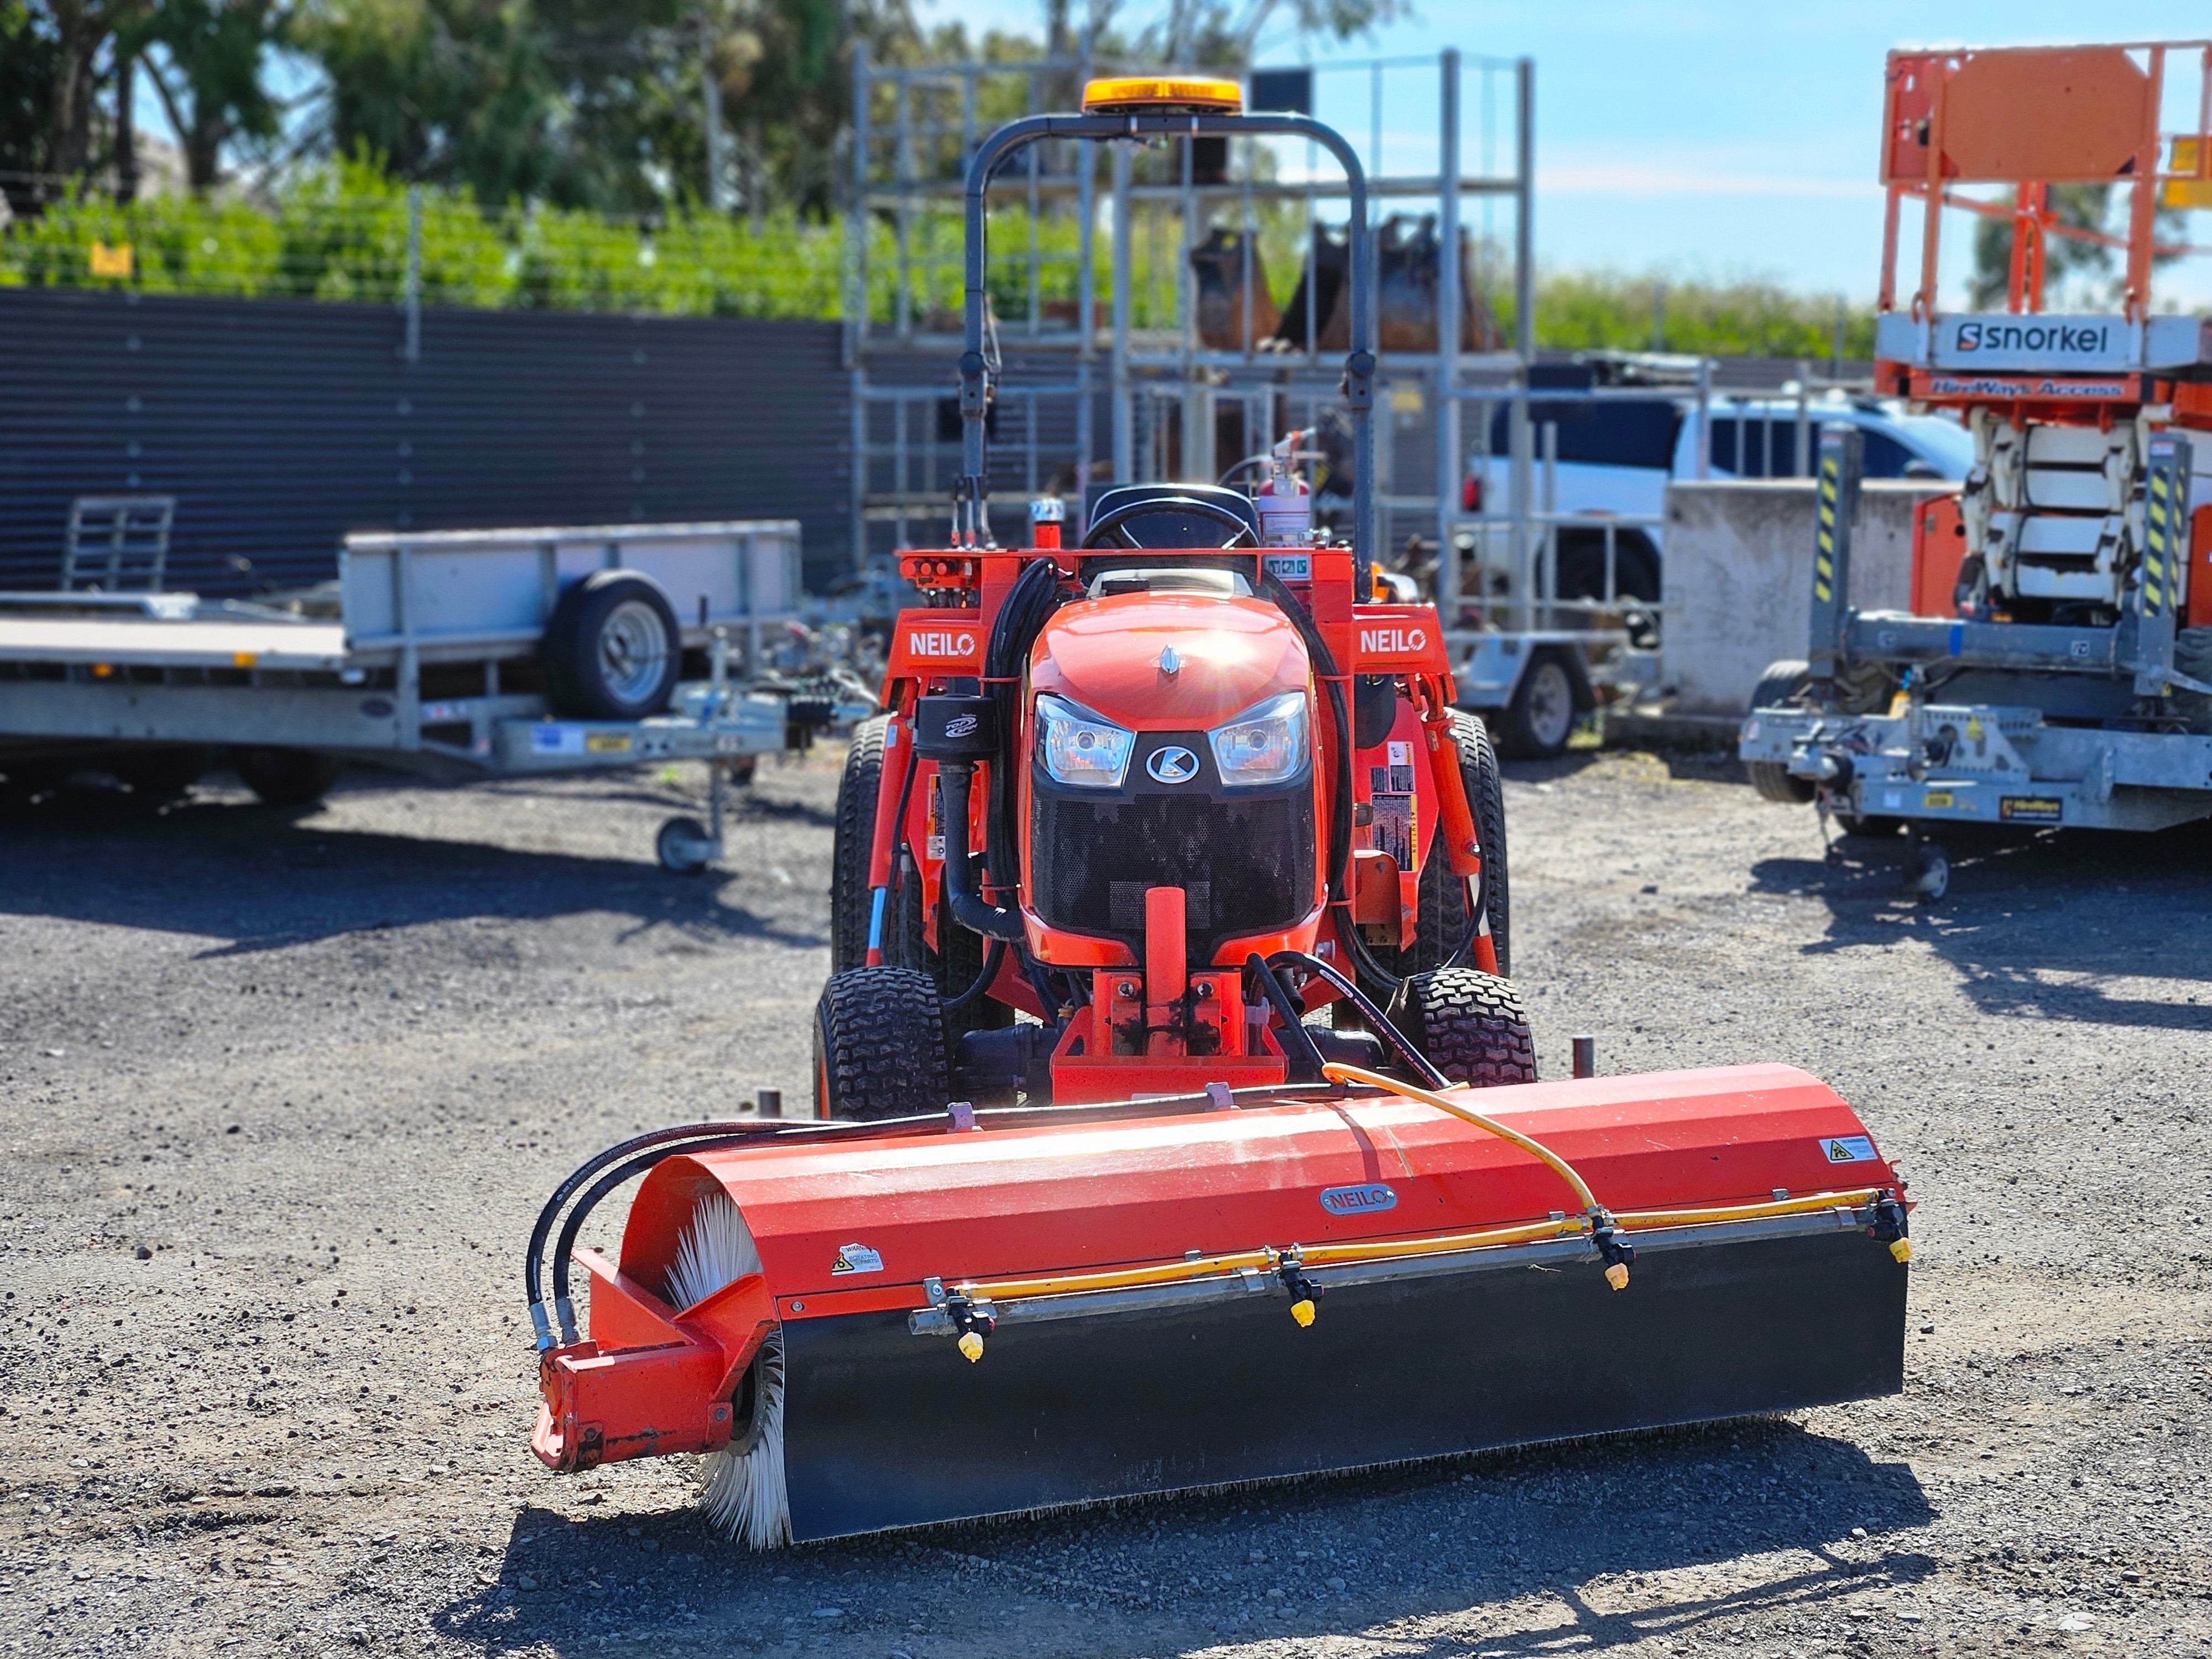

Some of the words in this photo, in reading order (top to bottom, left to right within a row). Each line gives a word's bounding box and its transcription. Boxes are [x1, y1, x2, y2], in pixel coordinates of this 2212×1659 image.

[1985, 325, 2107, 352] snorkel
[910, 633, 975, 656] NEILO
[1361, 629, 1426, 653] NEILO
[946, 721, 967, 730] TOP
[957, 723, 978, 734] SPIN
[1328, 1190, 1387, 1209] NEILO
